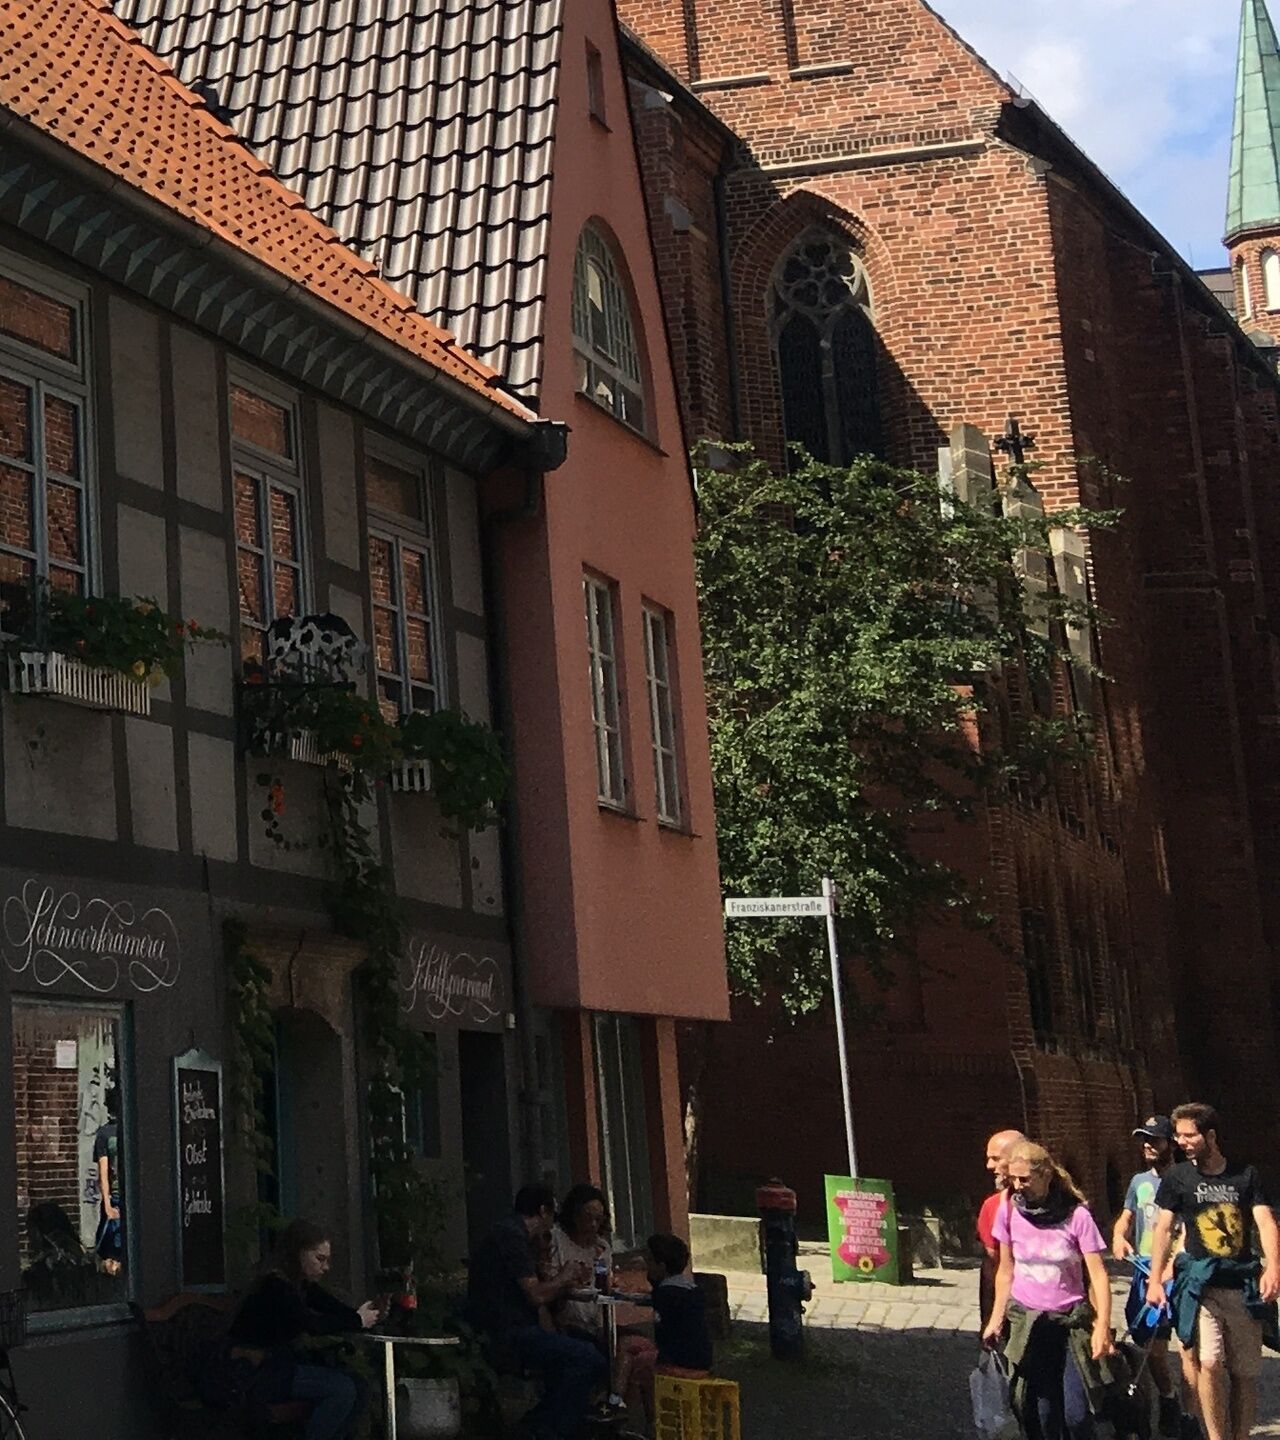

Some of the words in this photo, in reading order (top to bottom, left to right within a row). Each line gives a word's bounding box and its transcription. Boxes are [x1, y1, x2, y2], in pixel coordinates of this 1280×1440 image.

[731, 901, 823, 913] Franziskanerstraße
[3, 880, 176, 982] Schnoorkrämerei
[185, 1137, 208, 1164] Obst
